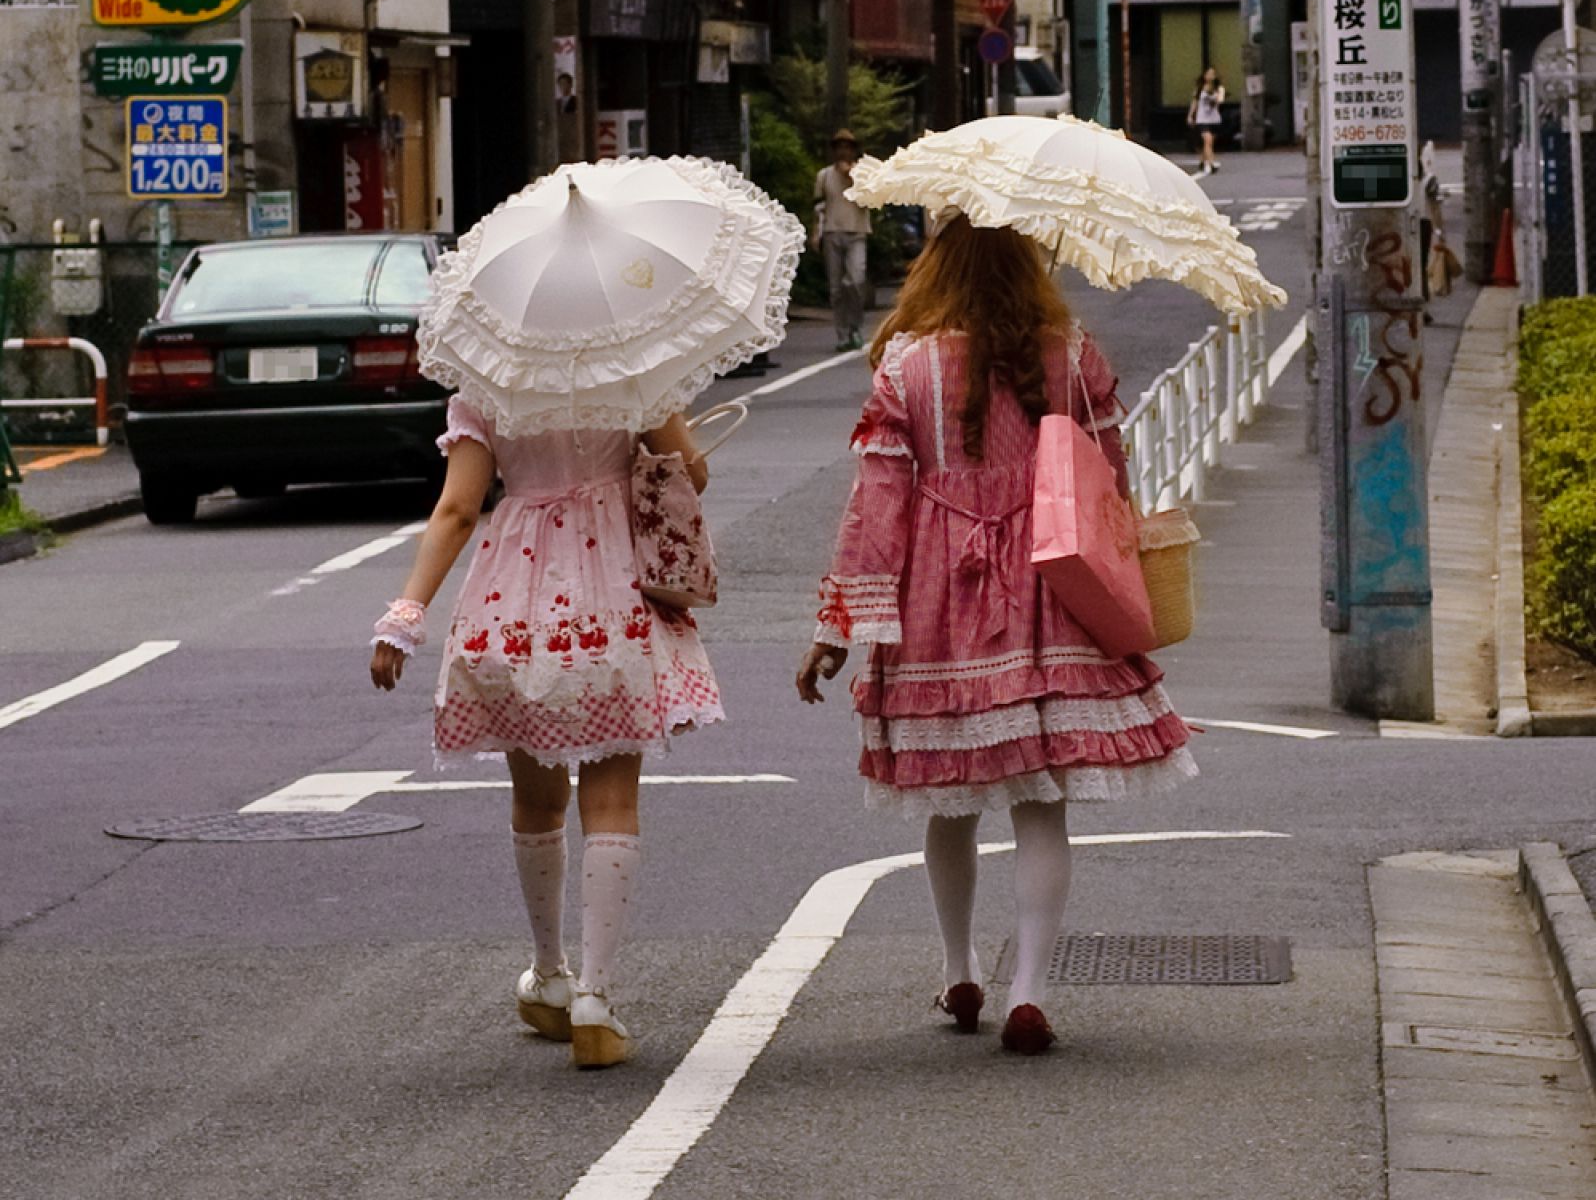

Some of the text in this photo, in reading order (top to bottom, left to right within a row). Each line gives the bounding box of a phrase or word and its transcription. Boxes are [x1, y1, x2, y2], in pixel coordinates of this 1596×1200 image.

[102, 53, 228, 86] 三井のリパーク
[135, 122, 218, 143] 最大料金
